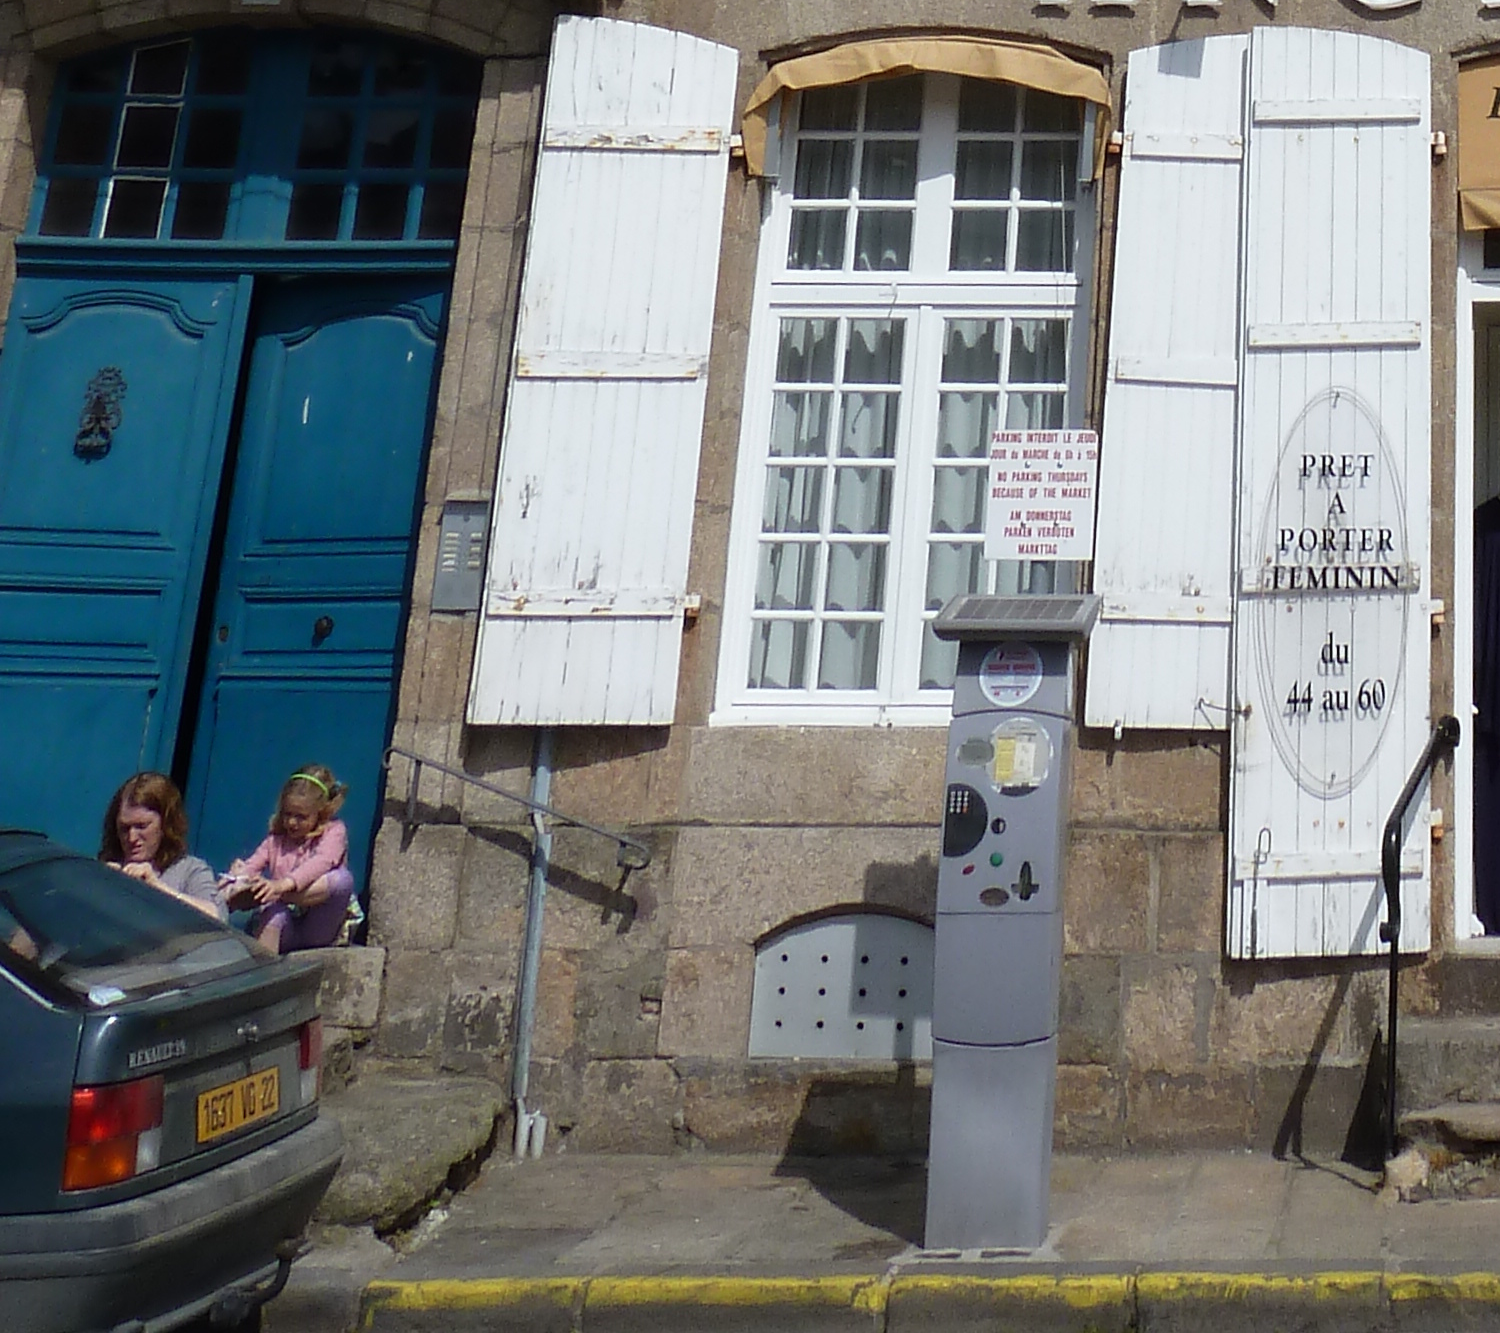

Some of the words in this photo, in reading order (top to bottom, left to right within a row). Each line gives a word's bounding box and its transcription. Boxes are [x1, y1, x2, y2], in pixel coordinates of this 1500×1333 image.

[991, 432, 1022, 443] PARKING
[1026, 432, 1058, 443] INTERDIT
[1063, 432, 1072, 443] LE
[1077, 432, 1097, 443] JEUDI
[990, 449, 1007, 460] JOUR
[1022, 449, 1049, 460] MARCHE
[1300, 454, 1375, 478] PRET
[997, 472, 1007, 482] NO
[1012, 472, 1042, 483] PARKING
[1048, 472, 1088, 483] THURSDAYS
[992, 487, 1024, 499] BECAUSE
[1029, 487, 1038, 499] OF
[1044, 487, 1056, 499] THE
[1061, 487, 1092, 499] MARKET
[1328, 491, 1347, 515] A
[1010, 510, 1022, 521] AM
[1026, 510, 1072, 521] DONNERSTAG
[1004, 526, 1032, 538] PARKEN
[1037, 526, 1075, 538] VERBOTEN
[1279, 528, 1395, 552] PORTER
[1018, 543, 1058, 555] MARKTTAG
[1272, 566, 1401, 590] FEMININ
[1321, 631, 1349, 665] du
[1286, 679, 1314, 714] 44
[1322, 690, 1349, 711] au
[1357, 678, 1386, 711] 60
[203, 1090, 234, 1134] 1637
[261, 1074, 276, 1111] 22
